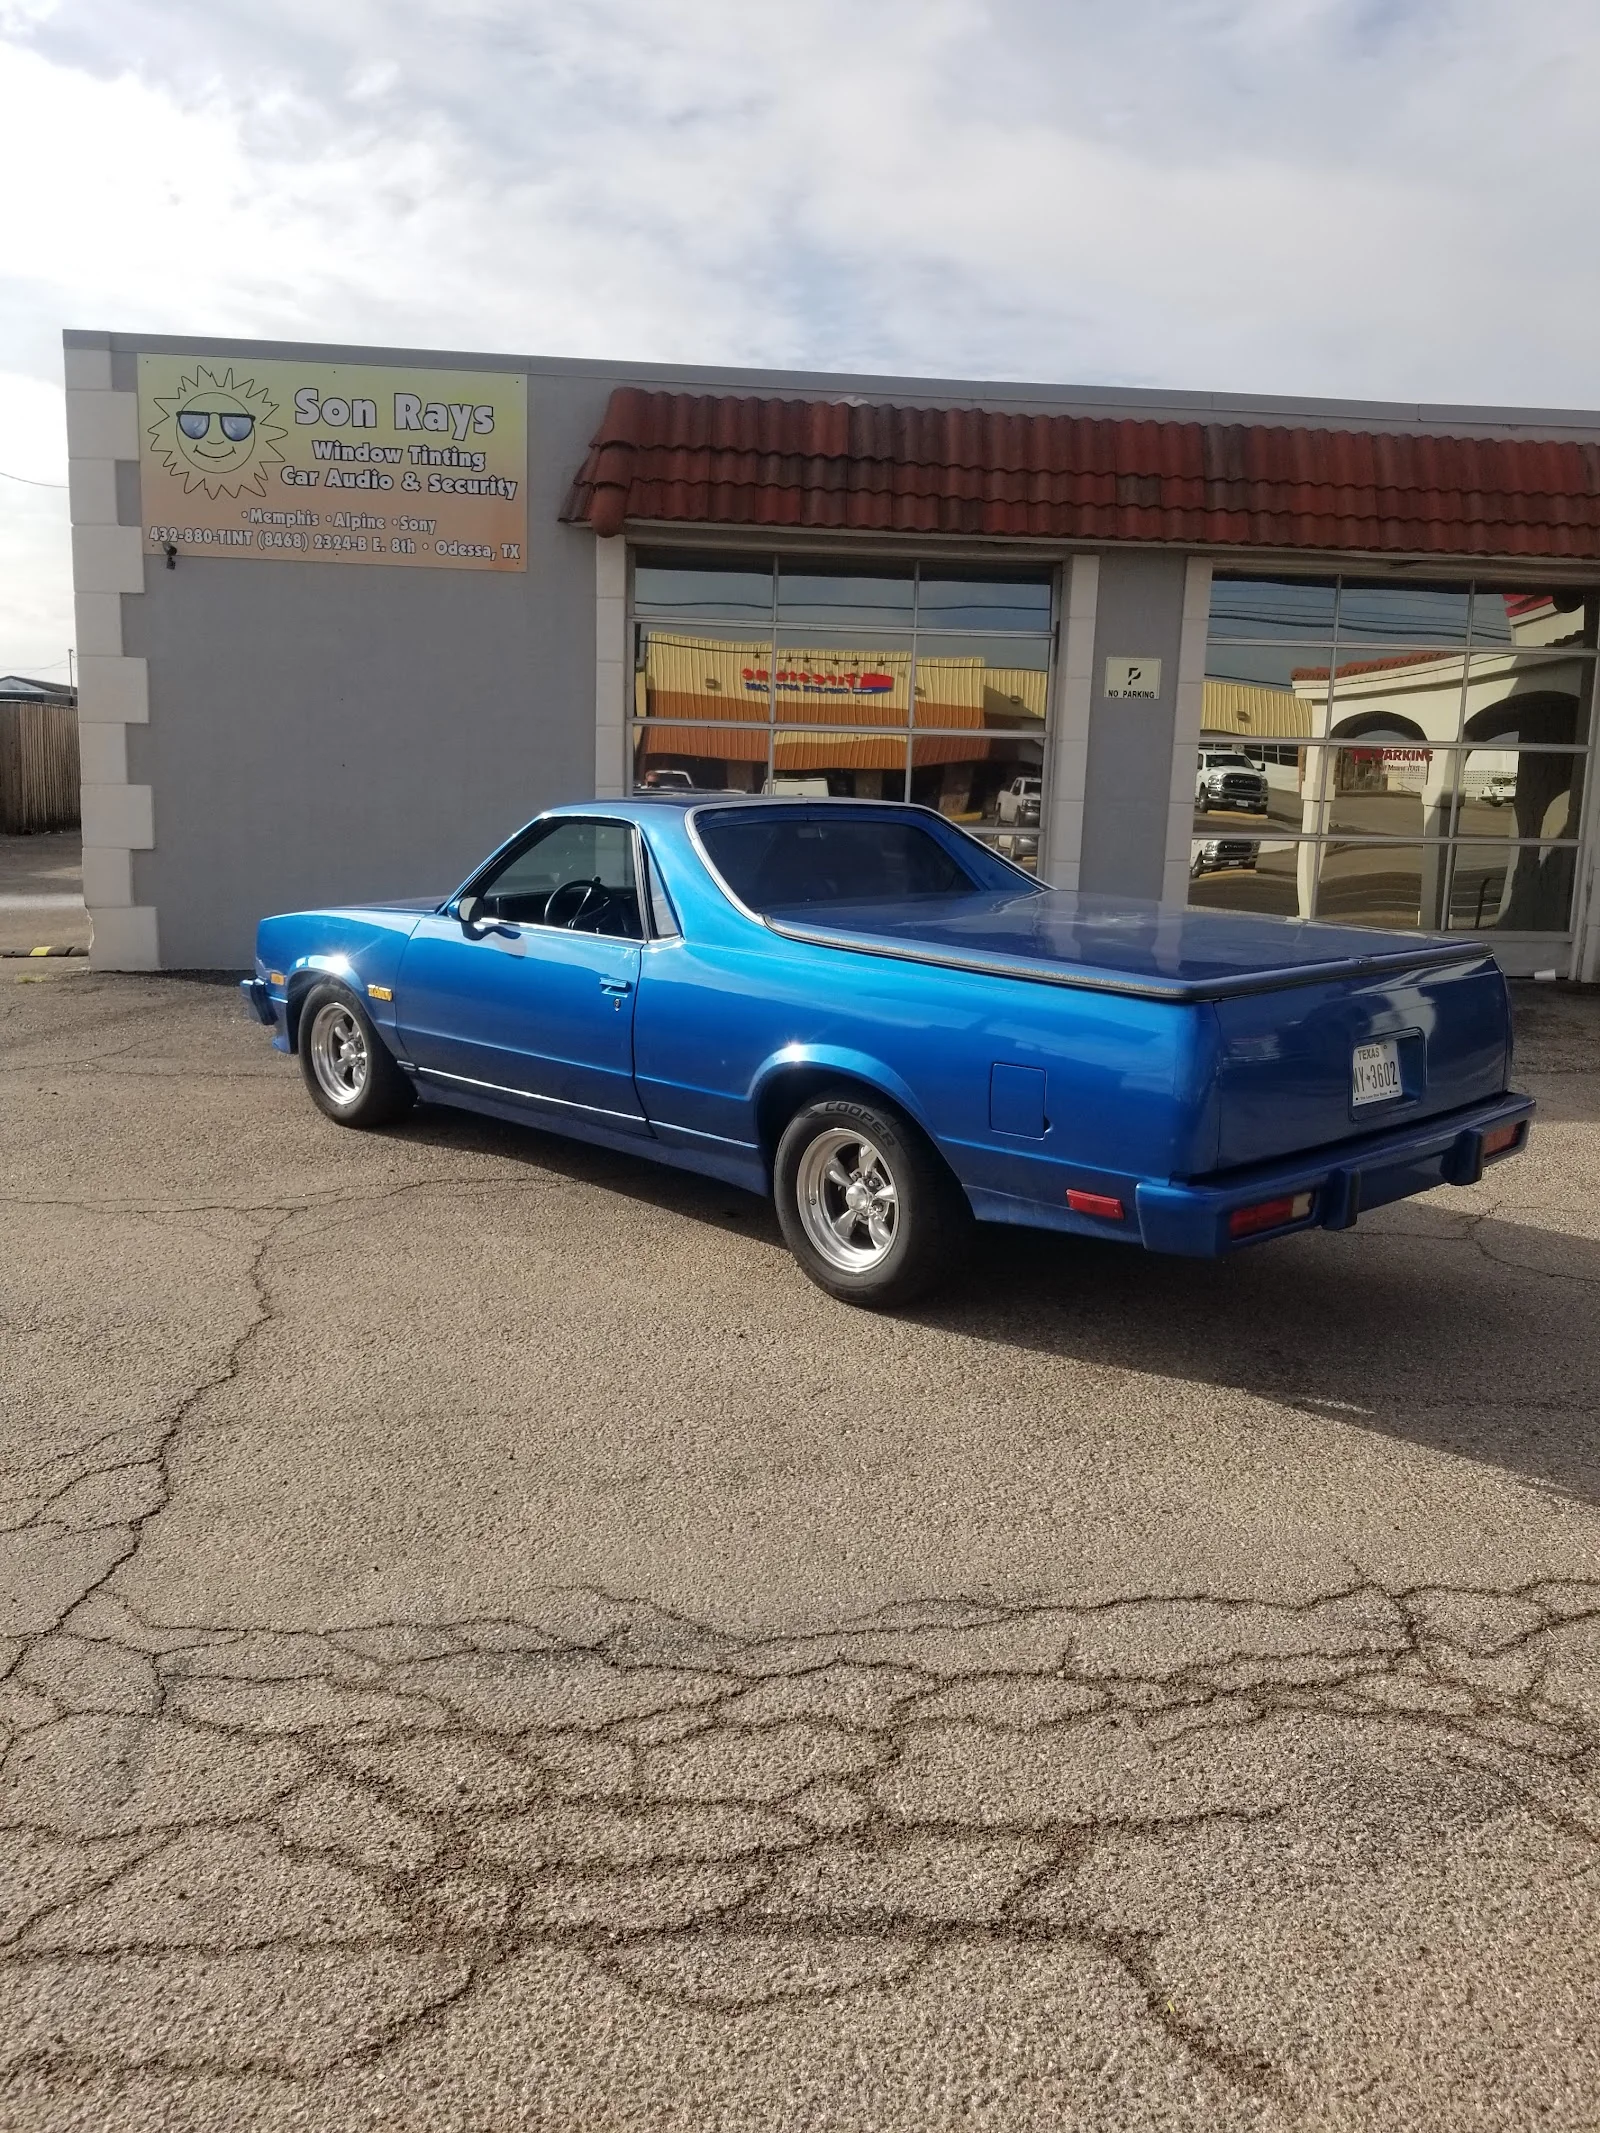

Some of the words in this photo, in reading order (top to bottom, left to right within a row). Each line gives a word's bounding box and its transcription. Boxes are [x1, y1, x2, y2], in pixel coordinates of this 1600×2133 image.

[294, 388, 377, 428] Son
[394, 392, 495, 441] Rays
[311, 440, 403, 463] Window
[408, 444, 486, 472] Tinting
[280, 466, 320, 487] Car
[324, 468, 394, 490] Audio
[400, 471, 421, 492] &
[428, 473, 518, 500] Security
[249, 508, 319, 528] Memphis
[333, 512, 386, 531] Alpine
[400, 515, 436, 535] Sony
[149, 526, 253, 546] 432-880-TINT
[257, 530, 309, 551] (8468)
[314, 534, 367, 551] 2324-B
[372, 537, 386, 552] E.
[391, 537, 416, 554] 8th
[435, 540, 496, 561] Odessa,
[501, 543, 520, 559] TX
[1108, 689, 1119, 698] NO
[1123, 690, 1155, 699] PARKING
[1357, 1047, 1380, 1060] TEXAS
[825, 1101, 896, 1146] COOPER
